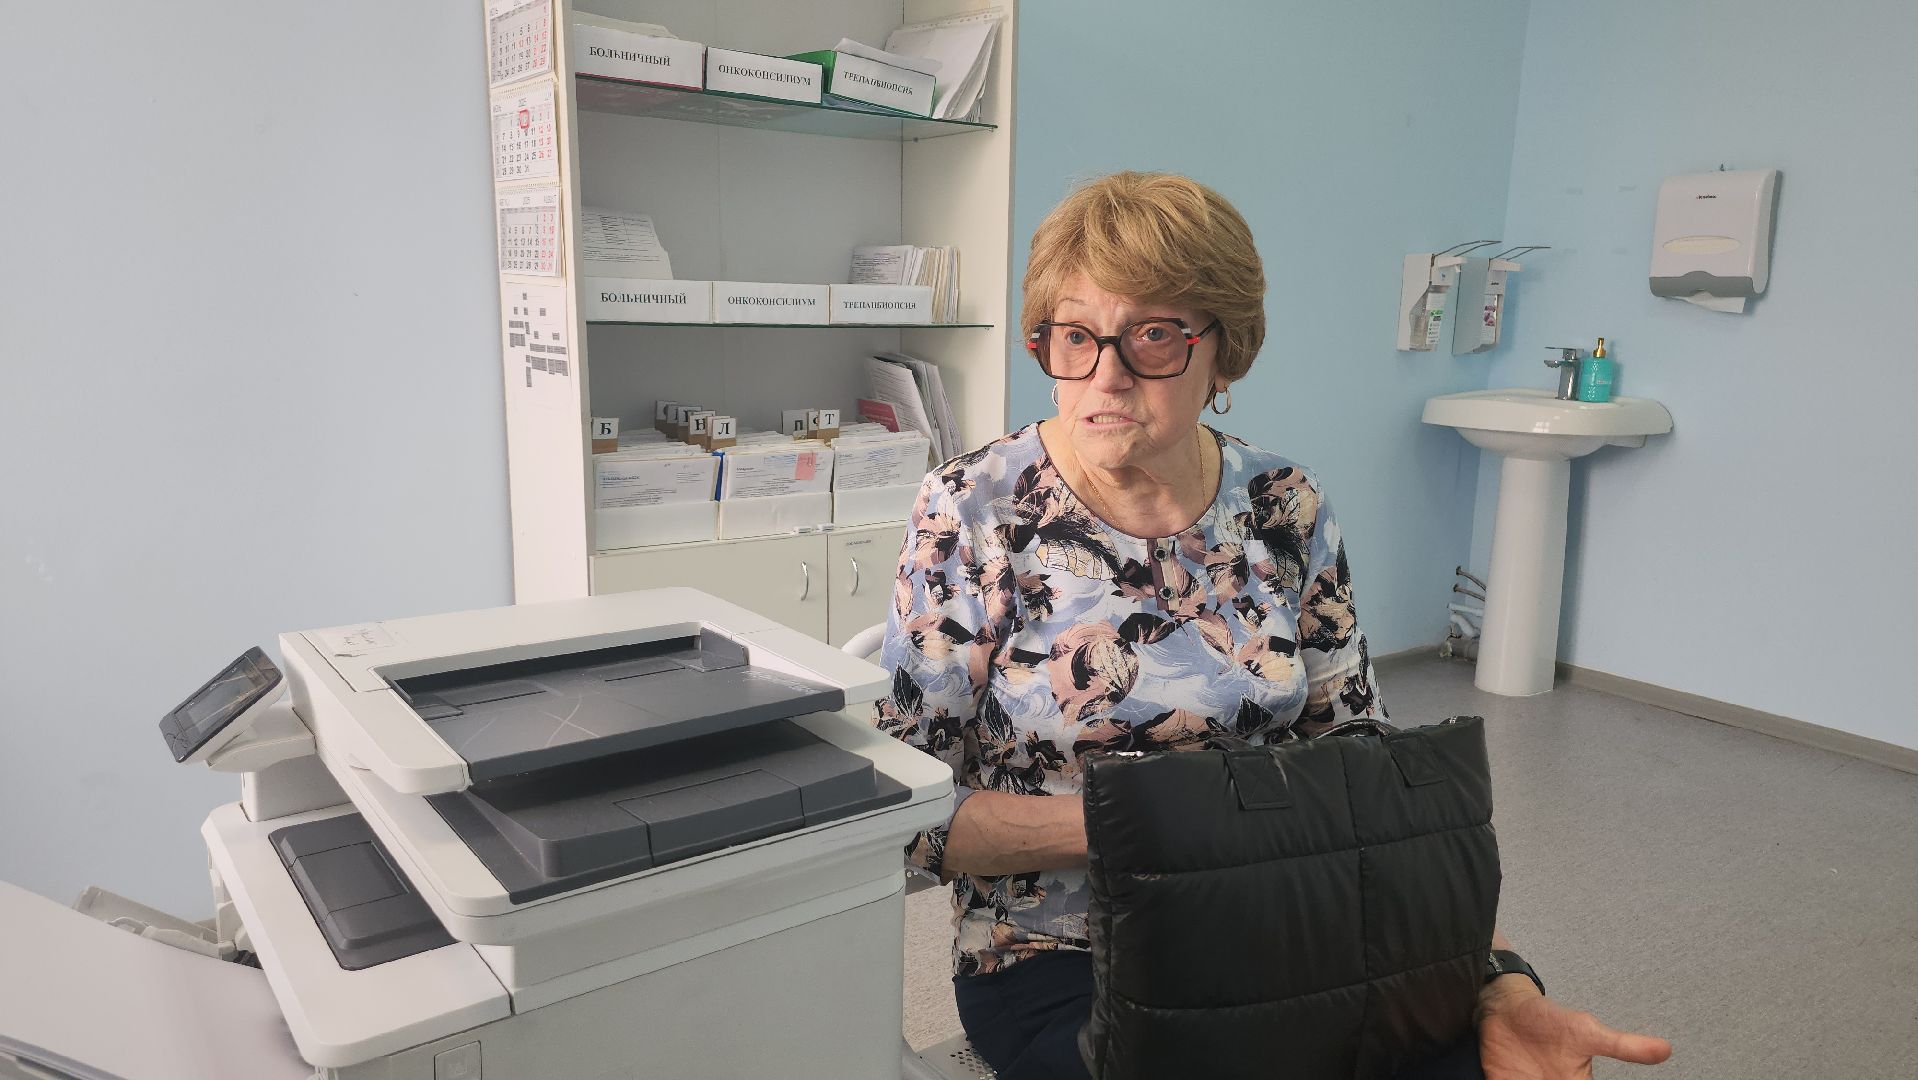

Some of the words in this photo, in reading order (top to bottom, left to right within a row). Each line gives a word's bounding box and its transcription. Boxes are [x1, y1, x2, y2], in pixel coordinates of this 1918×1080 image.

[589, 46, 671, 66] БОЛЬНИЧНЫЙ
[718, 64, 811, 86] ОНКОКОНСИЛИУМ
[600, 292, 687, 304] БОЛЬНИЧНЫЙ
[727, 295, 816, 306] ОНКОКОНСИЛИУМ
[825, 413, 835, 425] Т
[599, 422, 612, 436] Б
[718, 422, 730, 435] Л
